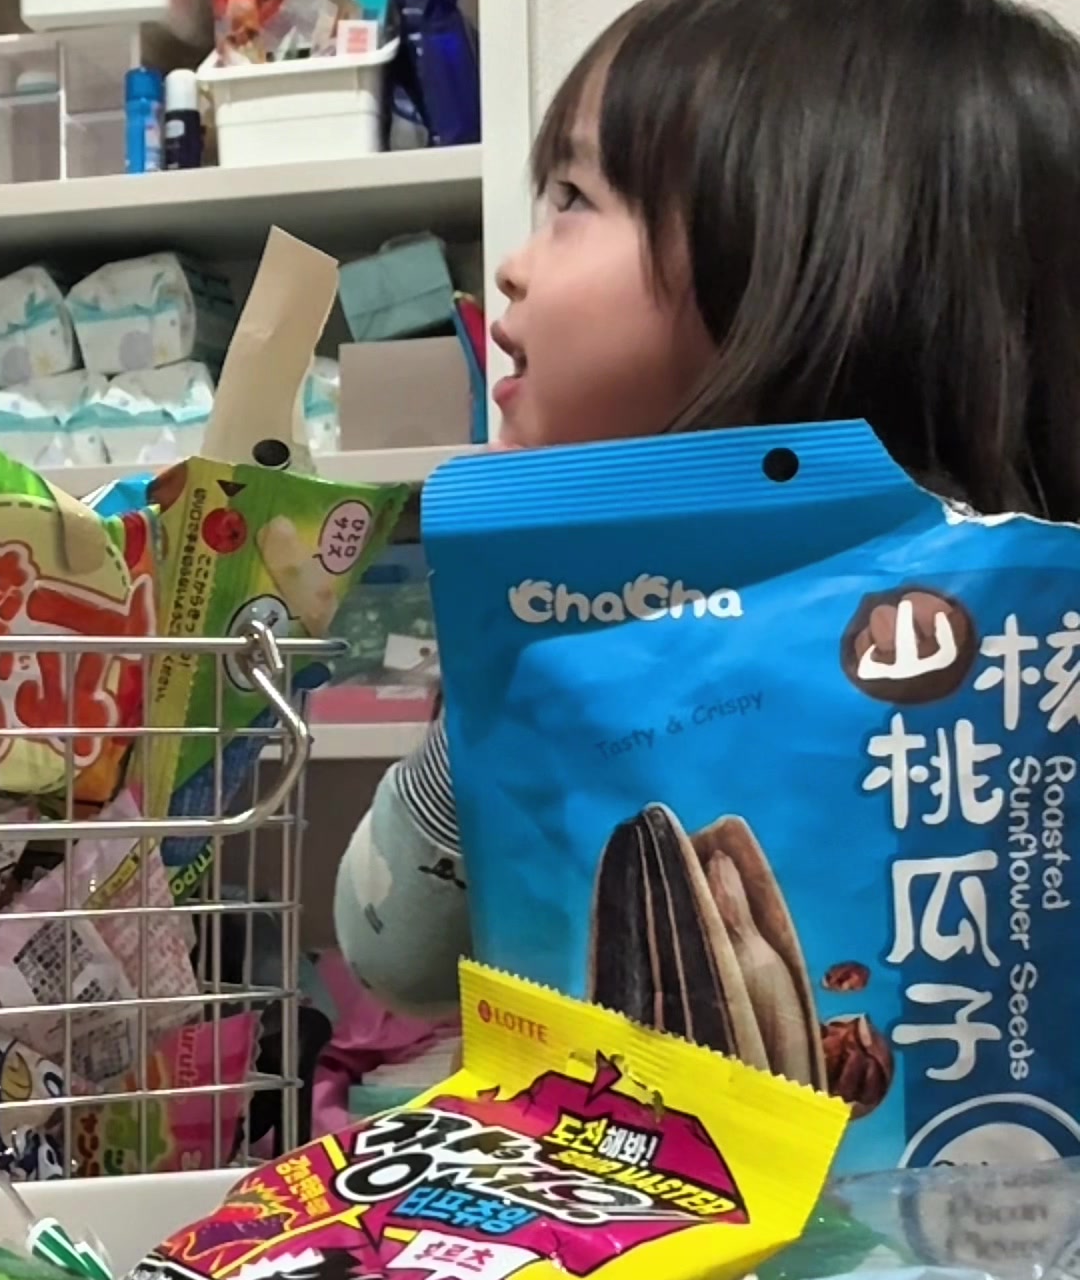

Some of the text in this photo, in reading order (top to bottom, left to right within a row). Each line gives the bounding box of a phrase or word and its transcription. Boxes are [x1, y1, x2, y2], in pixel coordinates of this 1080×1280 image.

[508, 573, 744, 623] ChaCha
[595, 689, 765, 761] Tasty & Crispy
[1042, 755, 1077, 910] Roasted
[1008, 756, 1041, 1081] Sunflower Seeds
[494, 1006, 549, 1043] LOTTE
[543, 1113, 658, 1167] 도전해봐!
[614, 1166, 736, 1215] MASTER
